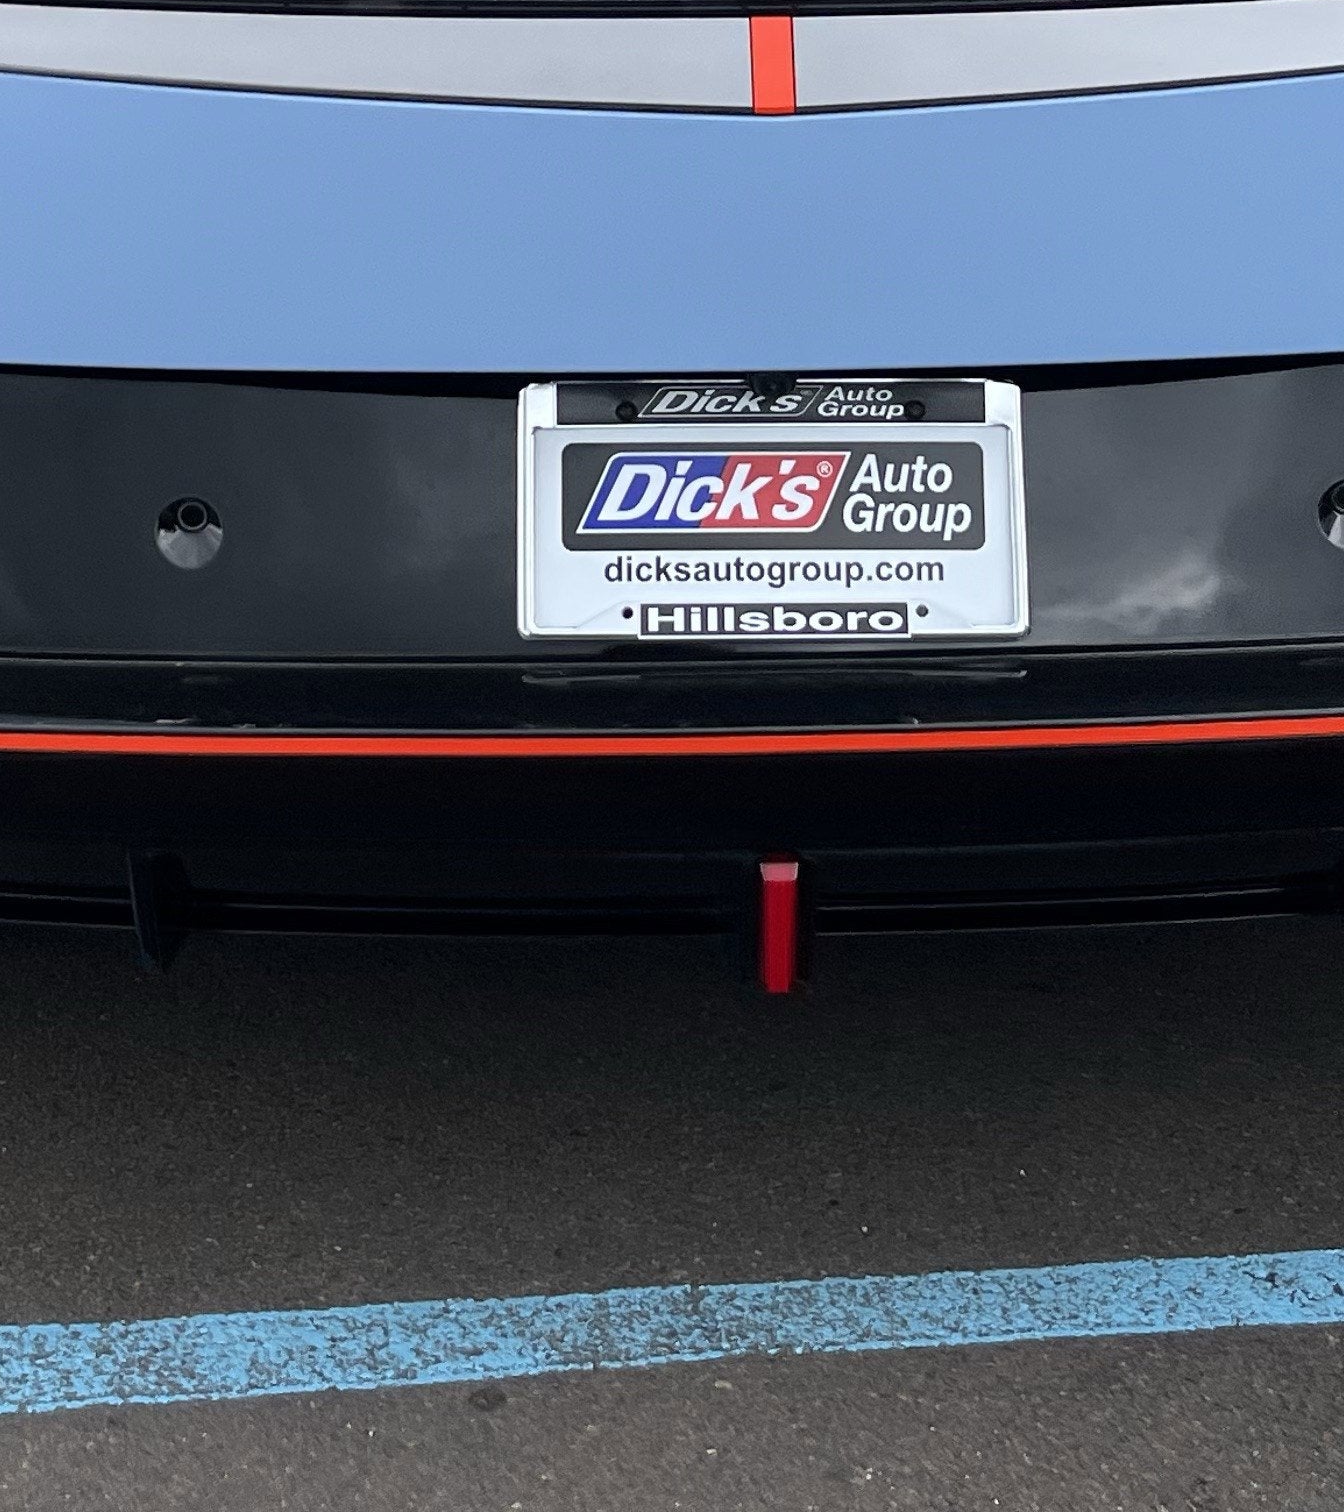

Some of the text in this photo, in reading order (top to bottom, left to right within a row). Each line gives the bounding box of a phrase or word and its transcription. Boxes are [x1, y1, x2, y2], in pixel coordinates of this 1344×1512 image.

[651, 386, 894, 413] Dicks Auto
[817, 401, 905, 420] Group
[597, 453, 953, 522] Dick's Auto
[842, 493, 972, 540] Group
[604, 556, 944, 588] dicksautogroup.com
[646, 606, 904, 633] Hillsboro
